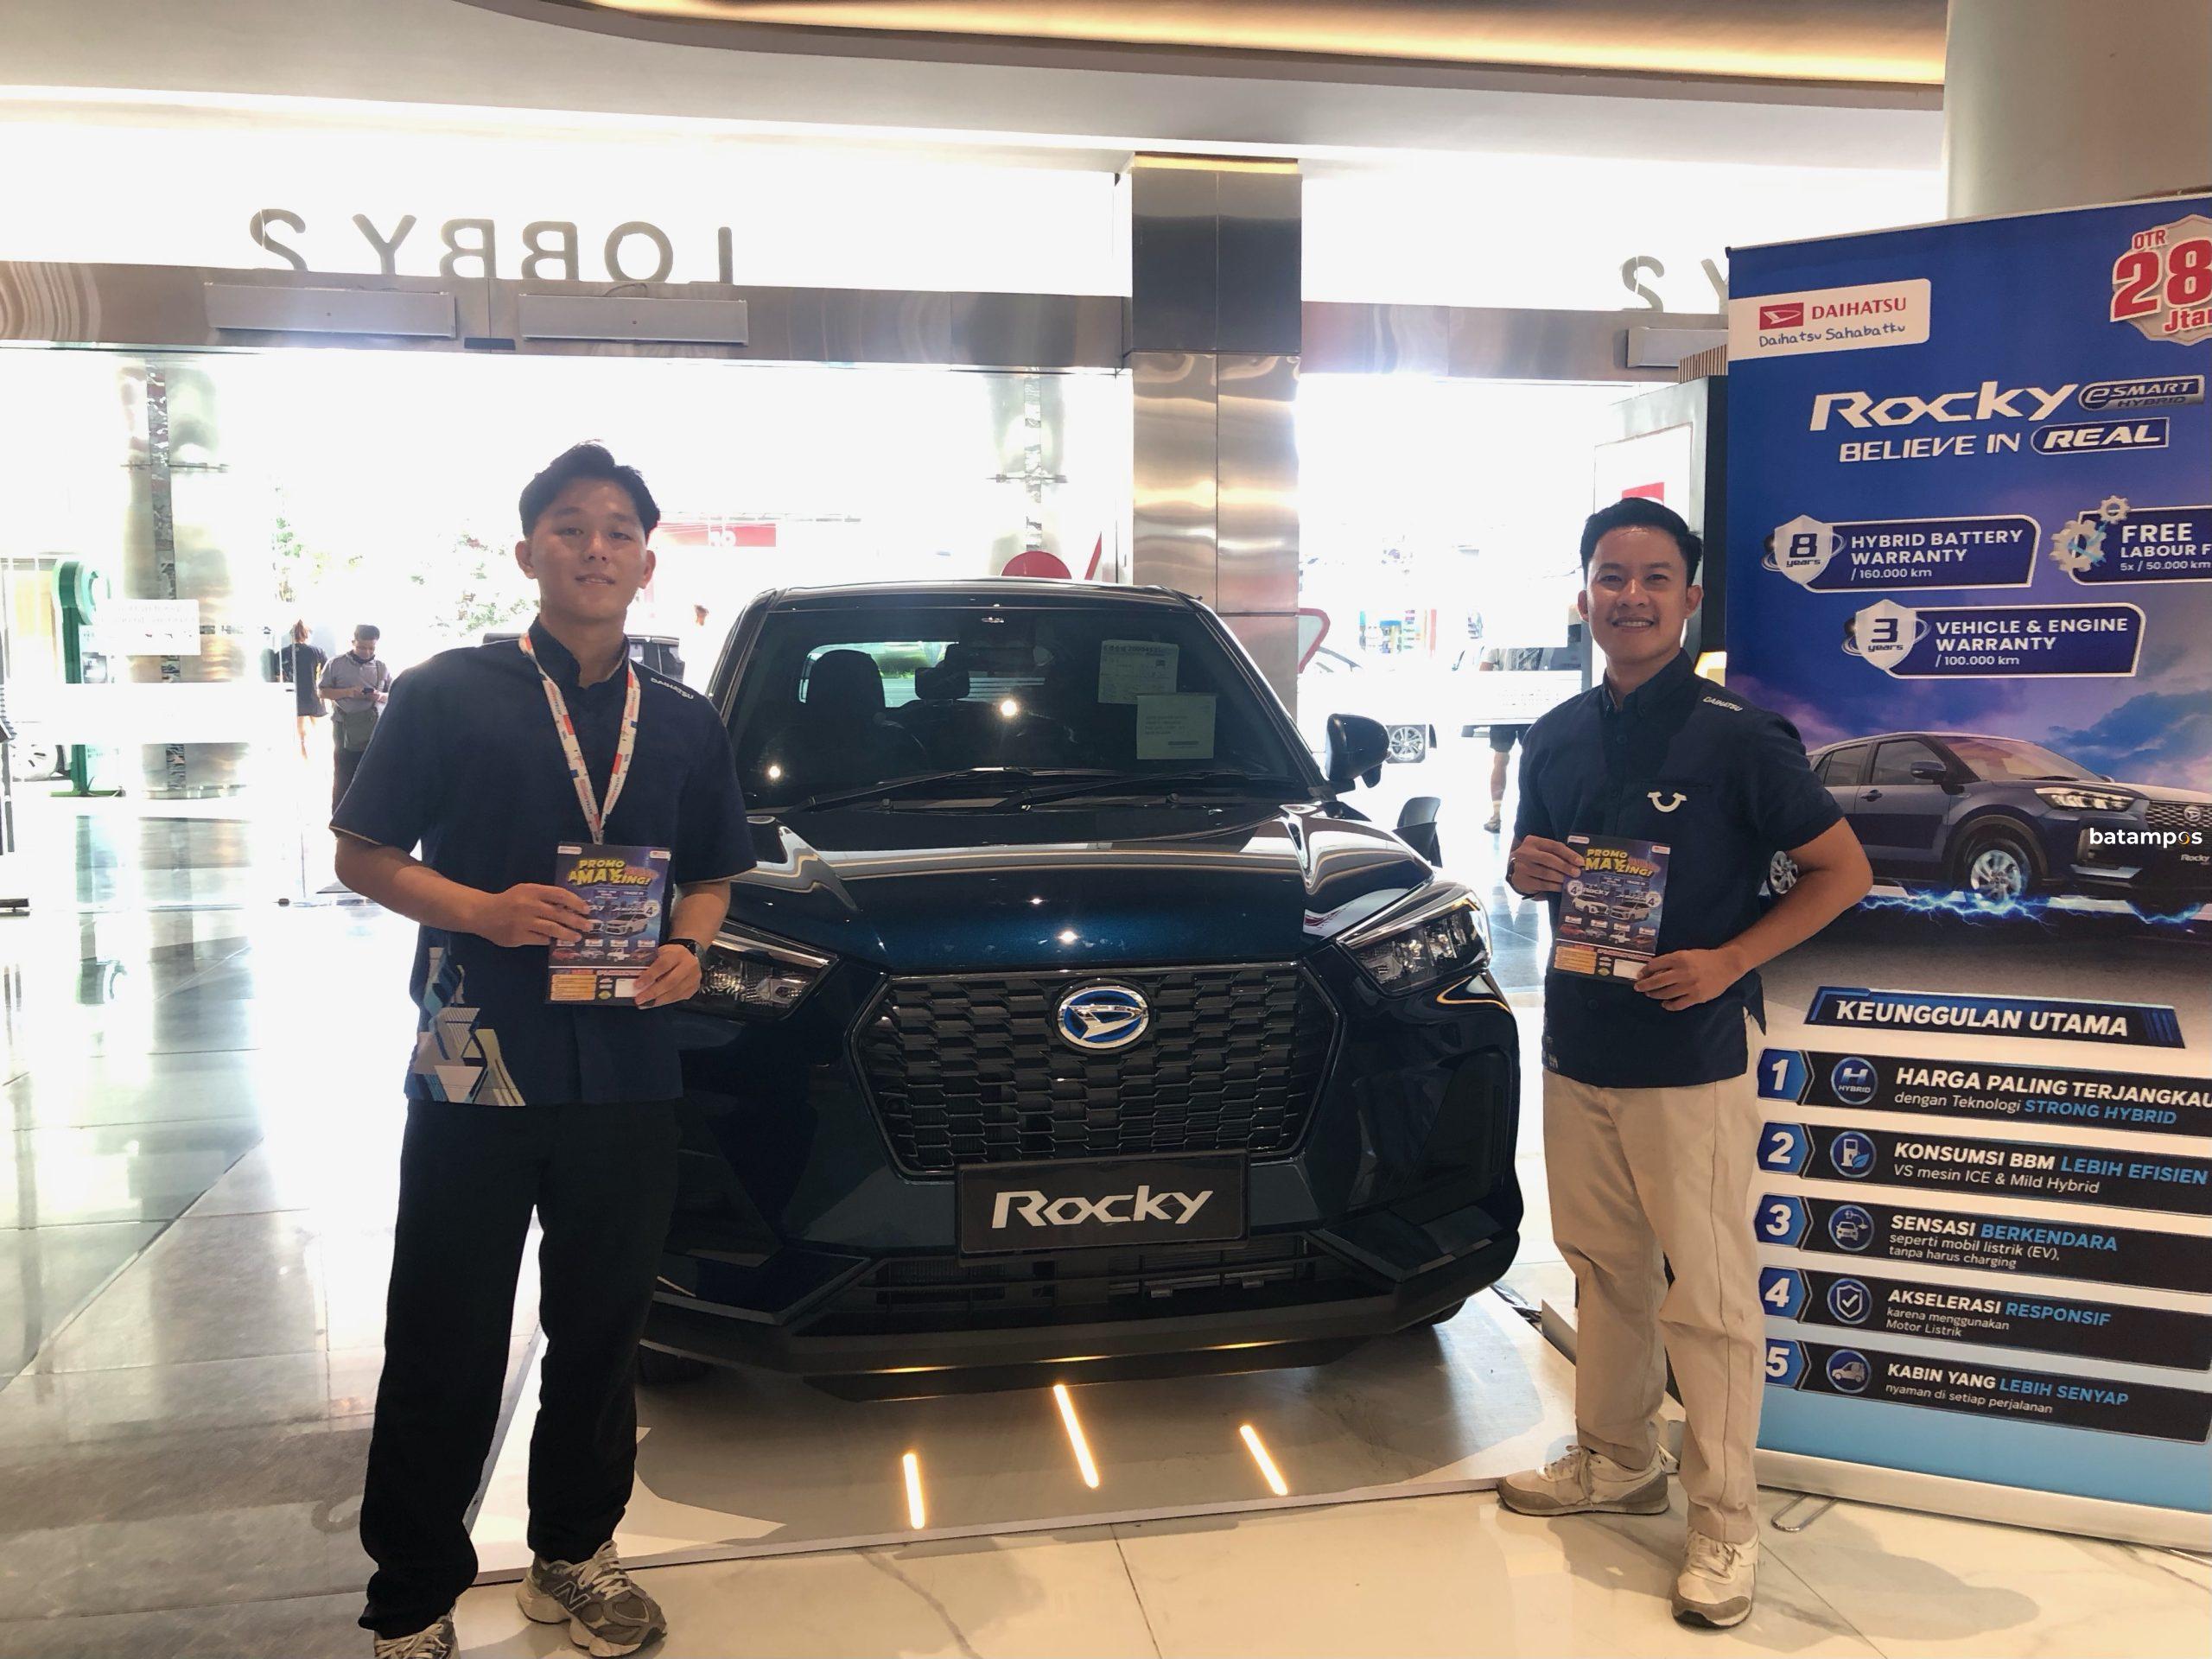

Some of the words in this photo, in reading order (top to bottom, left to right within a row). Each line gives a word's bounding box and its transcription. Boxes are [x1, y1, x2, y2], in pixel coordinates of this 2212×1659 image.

[2134, 229, 2165, 249] OTR
[1812, 297, 1906, 320] DAIHATSU
[1759, 332, 1821, 347] Daihatsu
[1809, 381, 2079, 430] Rocky
[2118, 397, 2185, 408] HYBRID
[1839, 435, 1977, 462] BELIEVE
[1986, 432, 2021, 453] IN
[2042, 423, 2160, 448] REAL
[1852, 533, 1925, 548] HYBRID
[1931, 530, 2023, 545] BATTERY
[2122, 523, 2192, 543] FREE
[1789, 533, 1817, 558] 8
[2121, 544, 2196, 557] LABOUR
[1786, 558, 1821, 568] years
[1852, 550, 1967, 565] WARRANTY
[2146, 561, 2188, 569] 50.000
[1859, 569, 1908, 579] 160.000
[1911, 569, 1932, 578] km
[1871, 618, 1898, 643] 3
[1936, 621, 2021, 635] VEHICLE
[2026, 620, 2041, 632] &
[2049, 618, 2128, 632] ENGINE
[1868, 644, 1904, 652] years
[1936, 637, 2056, 652] WARRANTY
[1944, 656, 1995, 665] 100.000
[1999, 656, 2019, 665] km
[650, 677, 694, 700] DAIHATSU
[1703, 696, 1743, 712] DAIHATSU
[579, 859, 625, 868] PROMO
[1586, 849, 1628, 858] PROMO
[1835, 1000, 2023, 1029] KEUNGGULAN
[2029, 1014, 2128, 1037] UTAMA
[1771, 1059, 1789, 1090] 1
[1896, 1067, 1980, 1090] HARGA
[1986, 1075, 2068, 1096] PALING
[1894, 1091, 1948, 1109] dengan
[1952, 1094, 2021, 1115] Teknologi
[2024, 1099, 2100, 1118] STRONG
[2104, 1106, 2177, 1124] HYBRID
[1767, 1132, 1795, 1164] 2
[1894, 1142, 2005, 1166] KONSUMSI
[2009, 1154, 2055, 1170] BBM
[2061, 1156, 2122, 1177] LEBIH
[2128, 1164, 2209, 1185] EFISIEN
[1894, 1164, 1913, 1178] VS
[1917, 1167, 1961, 1182] mesin
[1965, 1171, 1991, 1184] ICE
[1995, 1174, 2005, 1185] &
[2011, 1173, 2042, 1188] Mild
[2047, 1176, 2100, 1194] Hybrid
[992, 1185, 1213, 1229] Rocky
[1766, 1204, 1791, 1236] 3
[1890, 1233, 1937, 1248] seperti
[1942, 1238, 1980, 1251] mobil
[1984, 1241, 2023, 1256] listrik
[1891, 1215, 1976, 1236] SENSASI
[1981, 1224, 2117, 1251] BERKENDARA
[1889, 1246, 1923, 1259] tanpa
[1927, 1249, 1960, 1262] harus
[1963, 1254, 2017, 1269] charging
[1765, 1277, 1790, 1308] 4
[1887, 1306, 1925, 1320] karena
[1929, 1313, 2010, 1331] menggunakan
[1888, 1289, 2001, 1314] AKSELERASI
[2005, 1302, 2111, 1326] RESPONSIF
[1886, 1319, 1921, 1332] Motor
[1925, 1322, 1961, 1337] Listrik
[1766, 1346, 1789, 1378] 5
[1888, 1363, 1942, 1382] KABIN
[1948, 1371, 1996, 1389] YANG
[1999, 1378, 2051, 1396] LEBIH
[2056, 1386, 2129, 1405] SENYAP
[1885, 1383, 1931, 1398] nyaman
[1935, 1389, 1945, 1399] di
[1949, 1392, 1986, 1406] setiap
[1988, 1397, 2053, 1414] perjalanan
